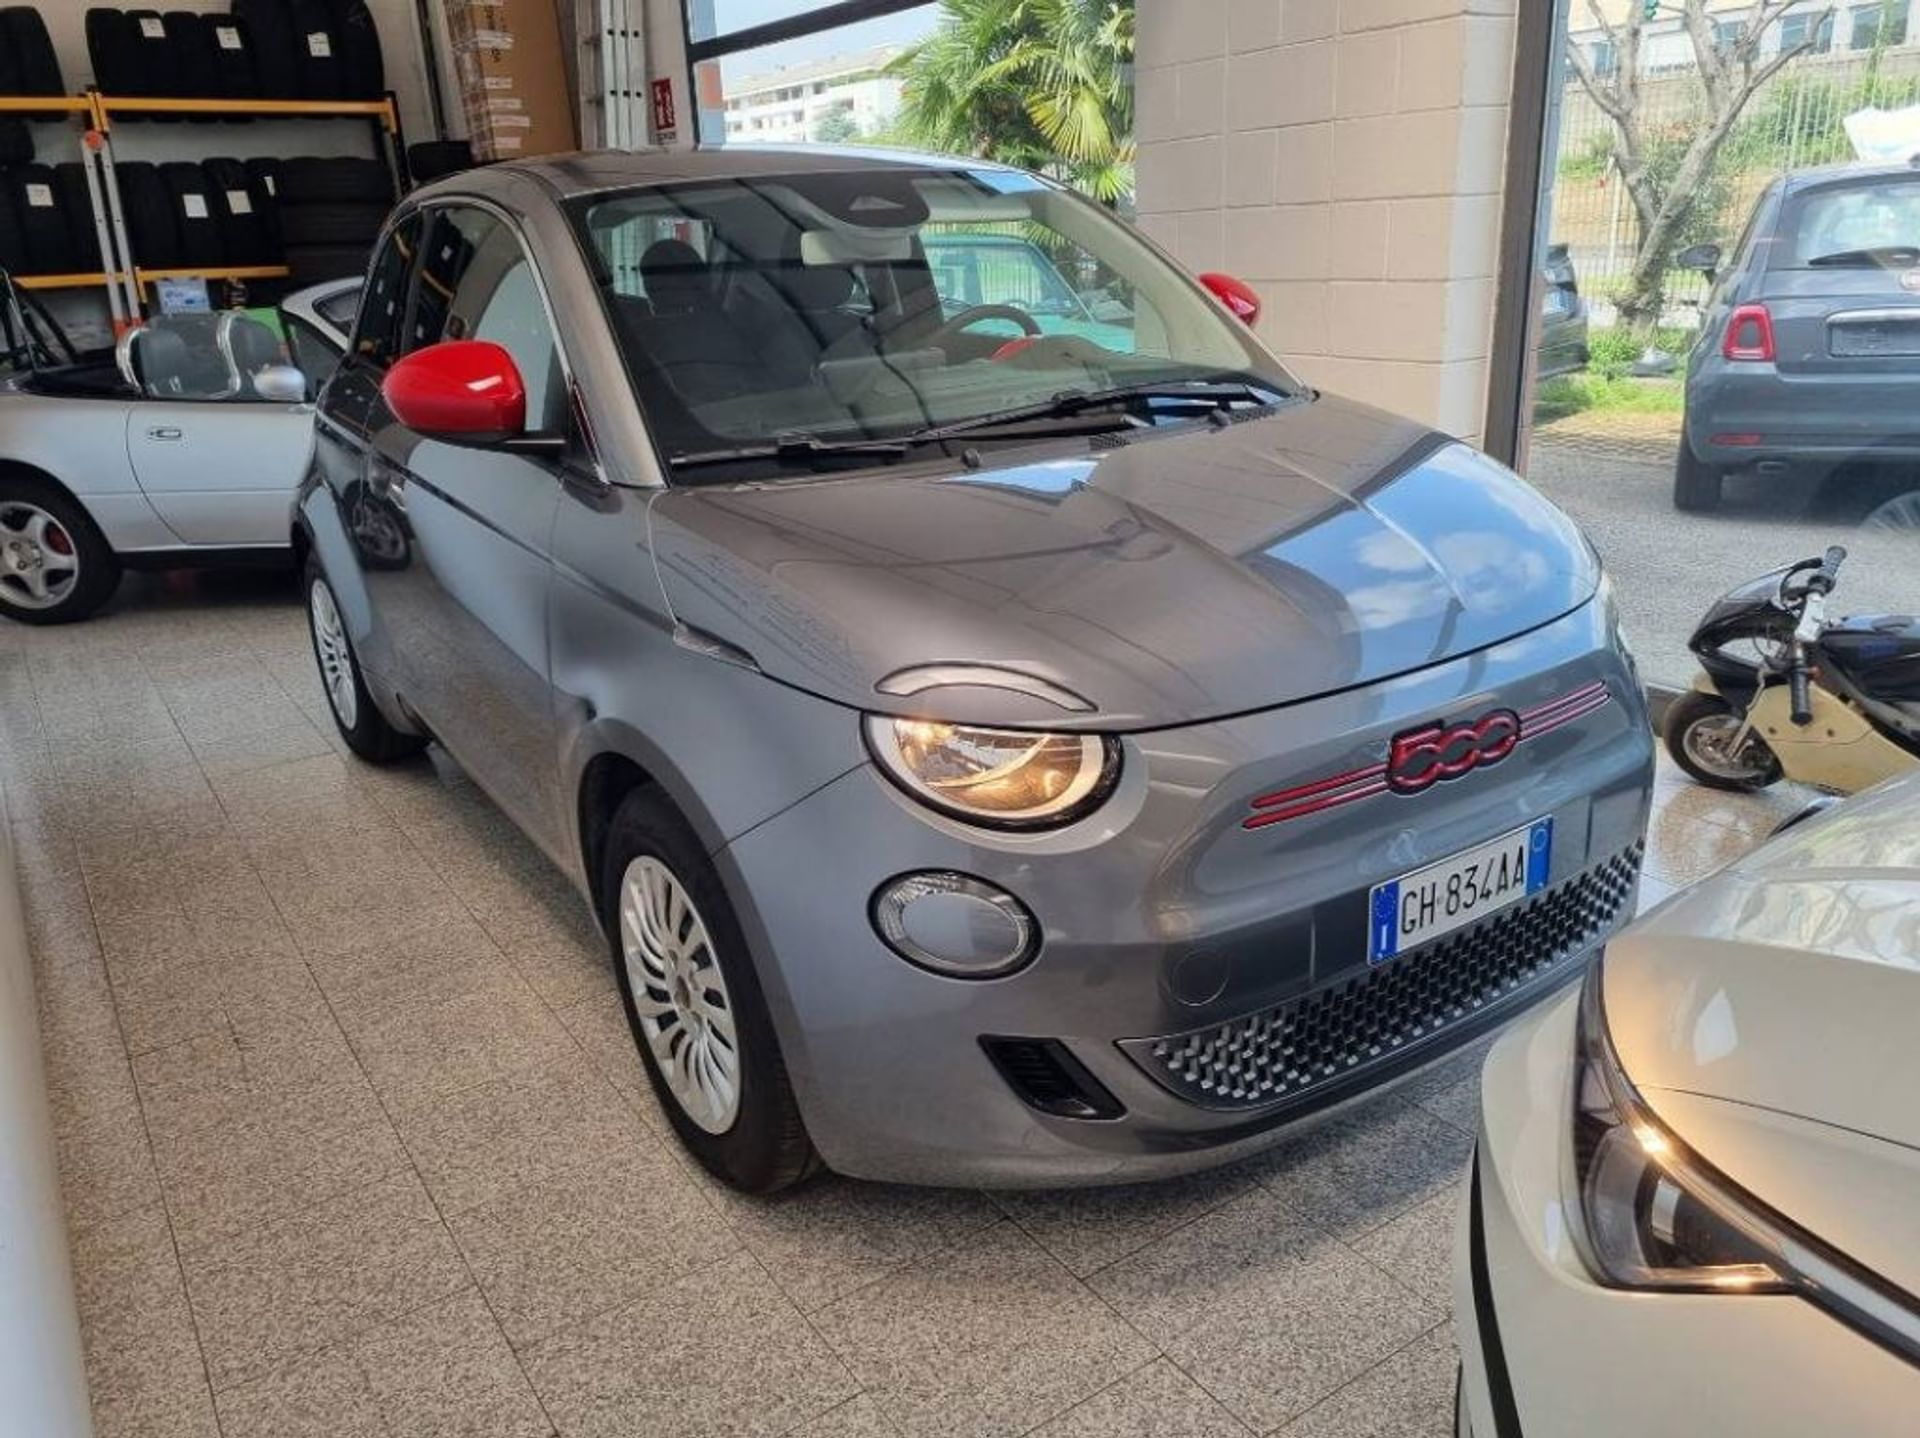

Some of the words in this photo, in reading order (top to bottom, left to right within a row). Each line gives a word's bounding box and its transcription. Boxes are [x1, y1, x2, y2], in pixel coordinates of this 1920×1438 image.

[1389, 709, 1520, 794] 500
[1401, 882, 1437, 935] GH
[1445, 845, 1525, 917] 834AA
[1380, 924, 1388, 951] I
